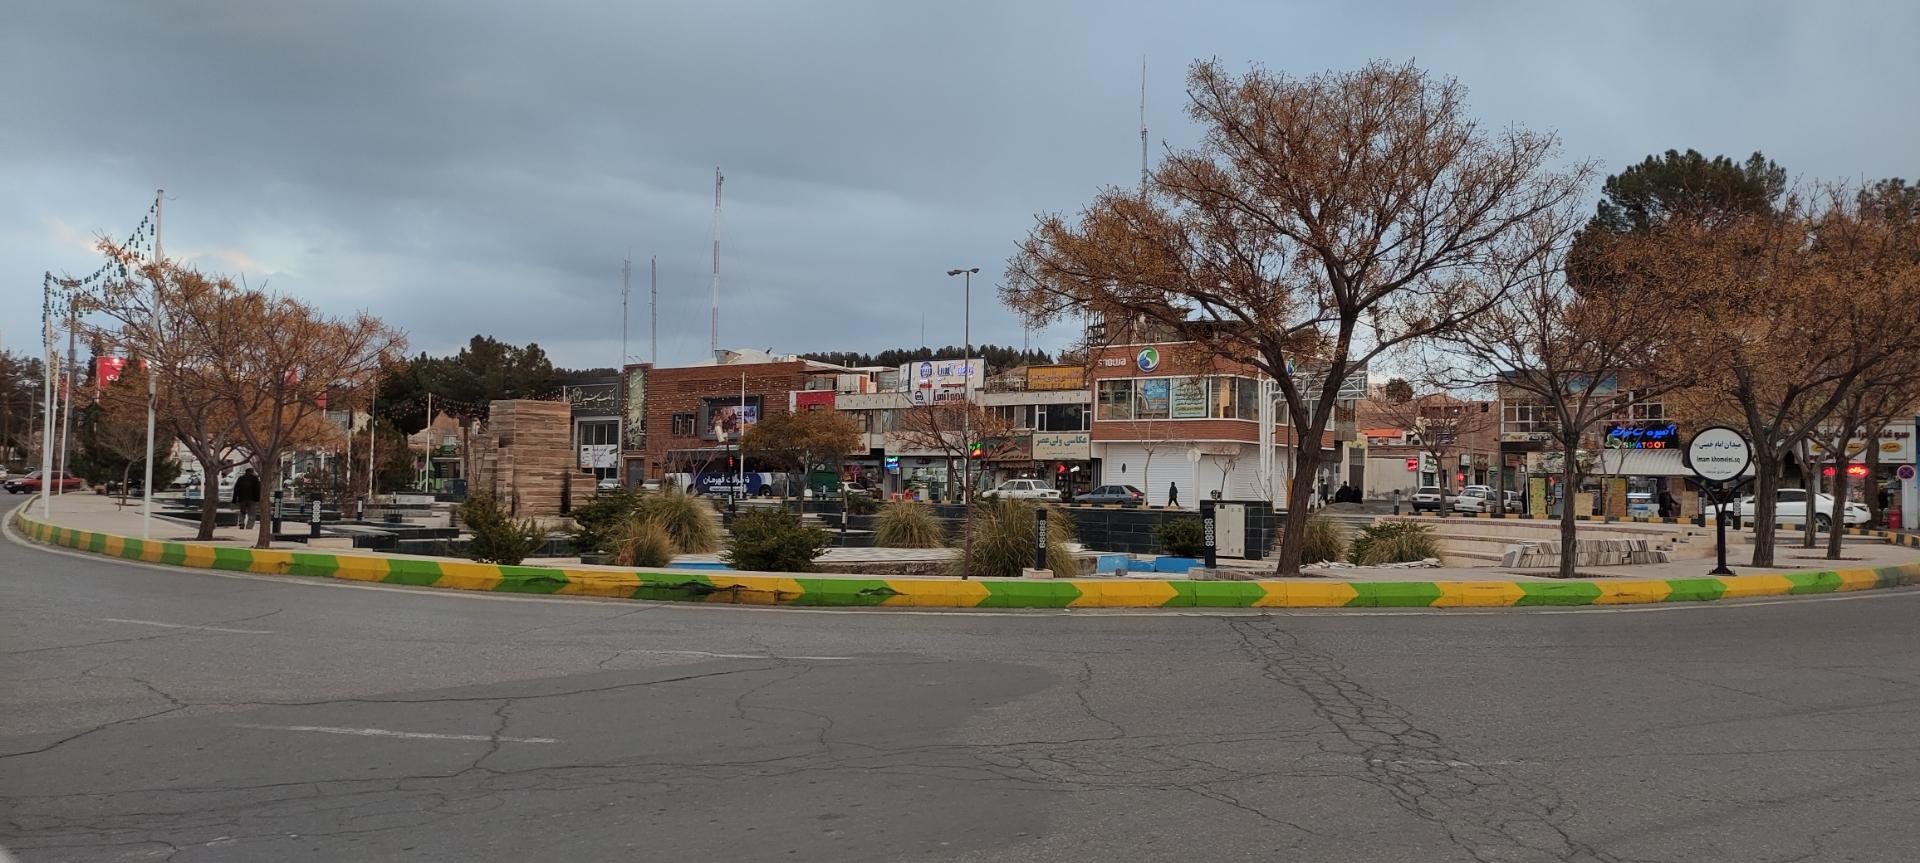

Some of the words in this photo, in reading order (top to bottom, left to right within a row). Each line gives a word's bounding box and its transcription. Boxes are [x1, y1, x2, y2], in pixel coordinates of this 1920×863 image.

[1097, 357, 1127, 368] snowa
[1064, 435, 1088, 447] عکاسی
[1699, 442, 1714, 450] خمینی
[1714, 440, 1724, 449] امام
[1724, 440, 1742, 450] میدان
